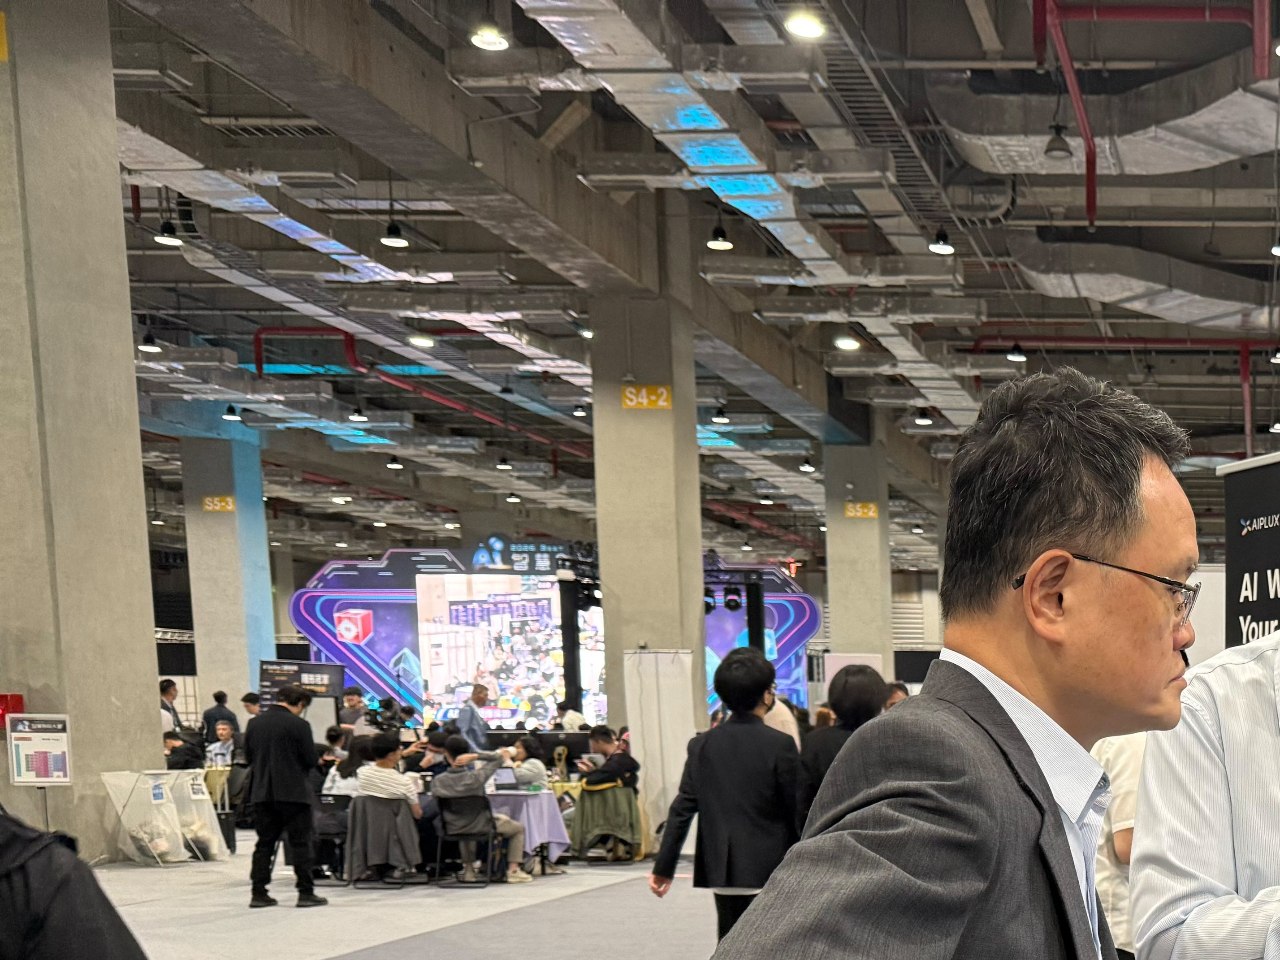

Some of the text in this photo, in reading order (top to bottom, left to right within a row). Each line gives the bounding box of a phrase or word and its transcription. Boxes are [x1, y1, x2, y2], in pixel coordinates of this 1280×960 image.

[625, 386, 668, 406] S4-2
[1251, 513, 1280, 532] AIPLUX
[1239, 571, 1259, 603] AI
[1238, 614, 1279, 645] Your
